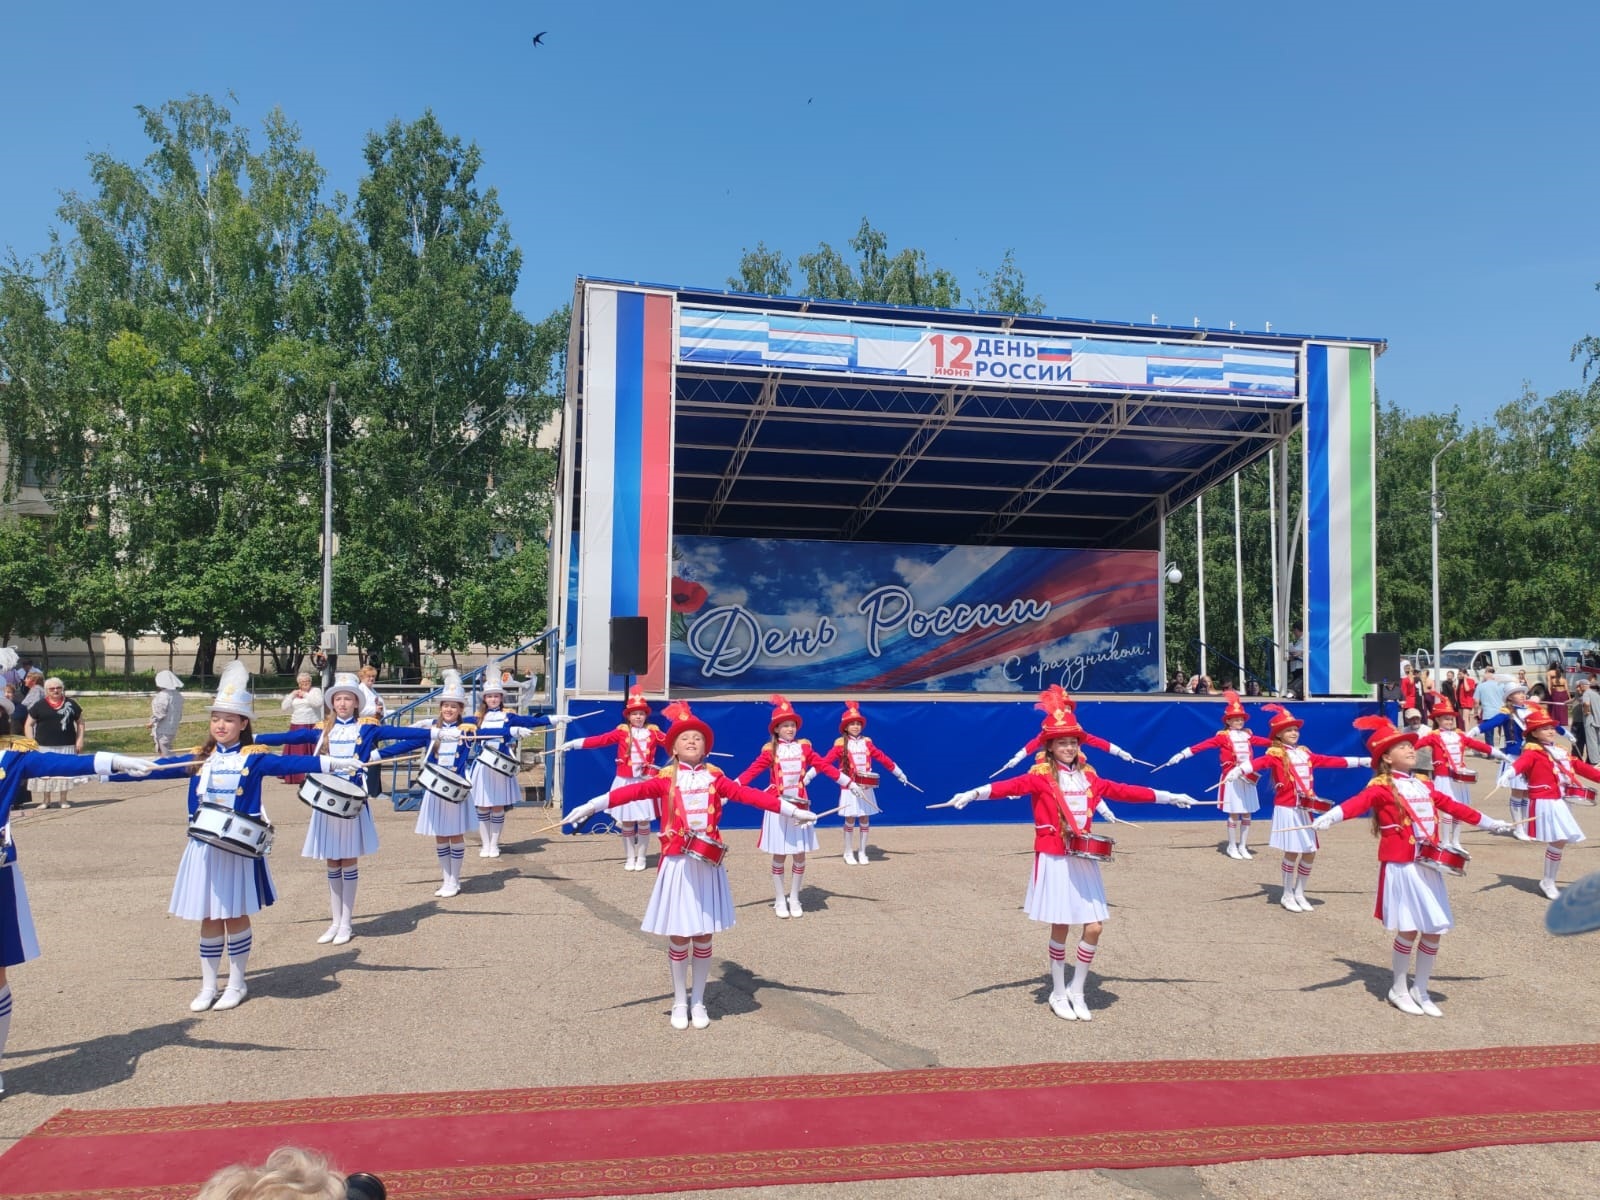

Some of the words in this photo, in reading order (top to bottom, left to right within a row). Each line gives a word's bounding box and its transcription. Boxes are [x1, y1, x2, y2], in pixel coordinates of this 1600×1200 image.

[929, 334, 973, 370] 12
[974, 339, 1036, 358] ДЕНЬ
[975, 361, 1072, 381] РОССИИ
[687, 604, 836, 677] День
[858, 584, 1052, 658] России
[1001, 655, 1022, 683] С
[1029, 631, 1153, 690] праздником!
